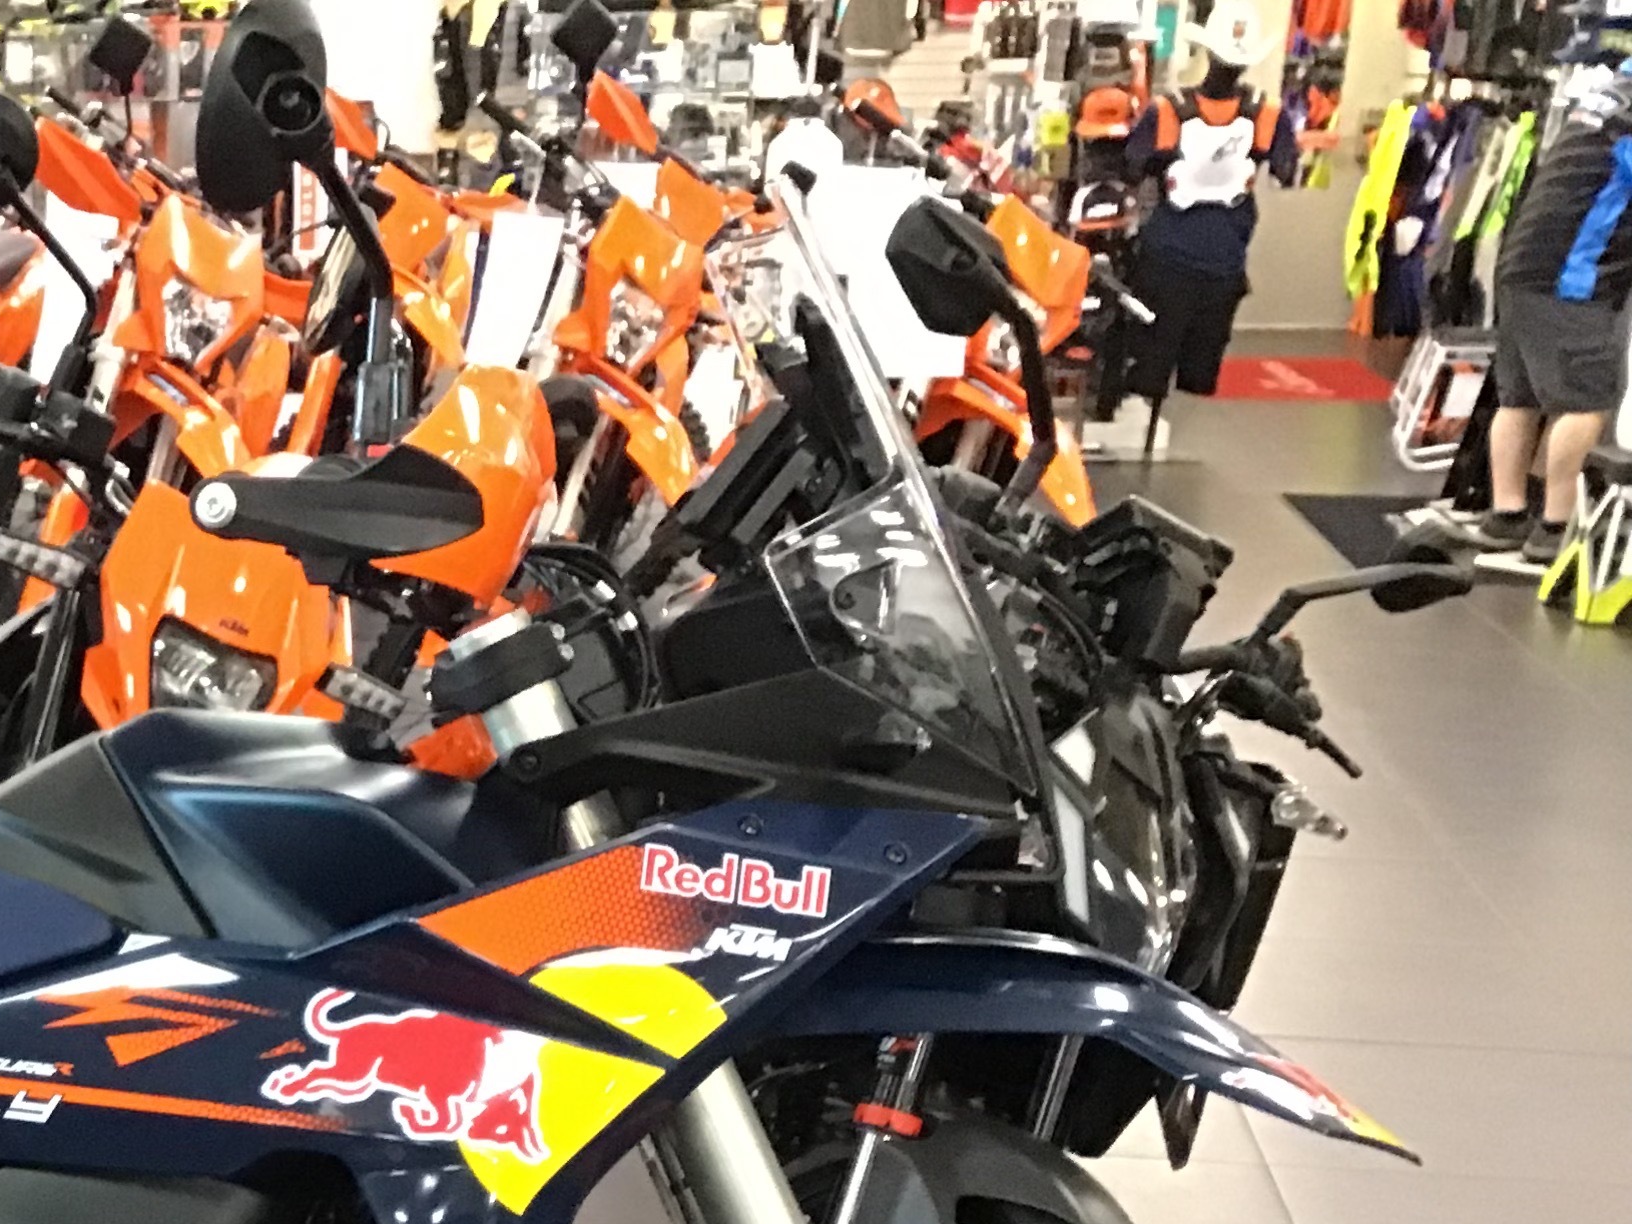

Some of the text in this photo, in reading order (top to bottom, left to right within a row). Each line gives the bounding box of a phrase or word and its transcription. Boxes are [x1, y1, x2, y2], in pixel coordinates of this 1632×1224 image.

[642, 845, 830, 916] Red Bull
[704, 923, 794, 961] KTM
